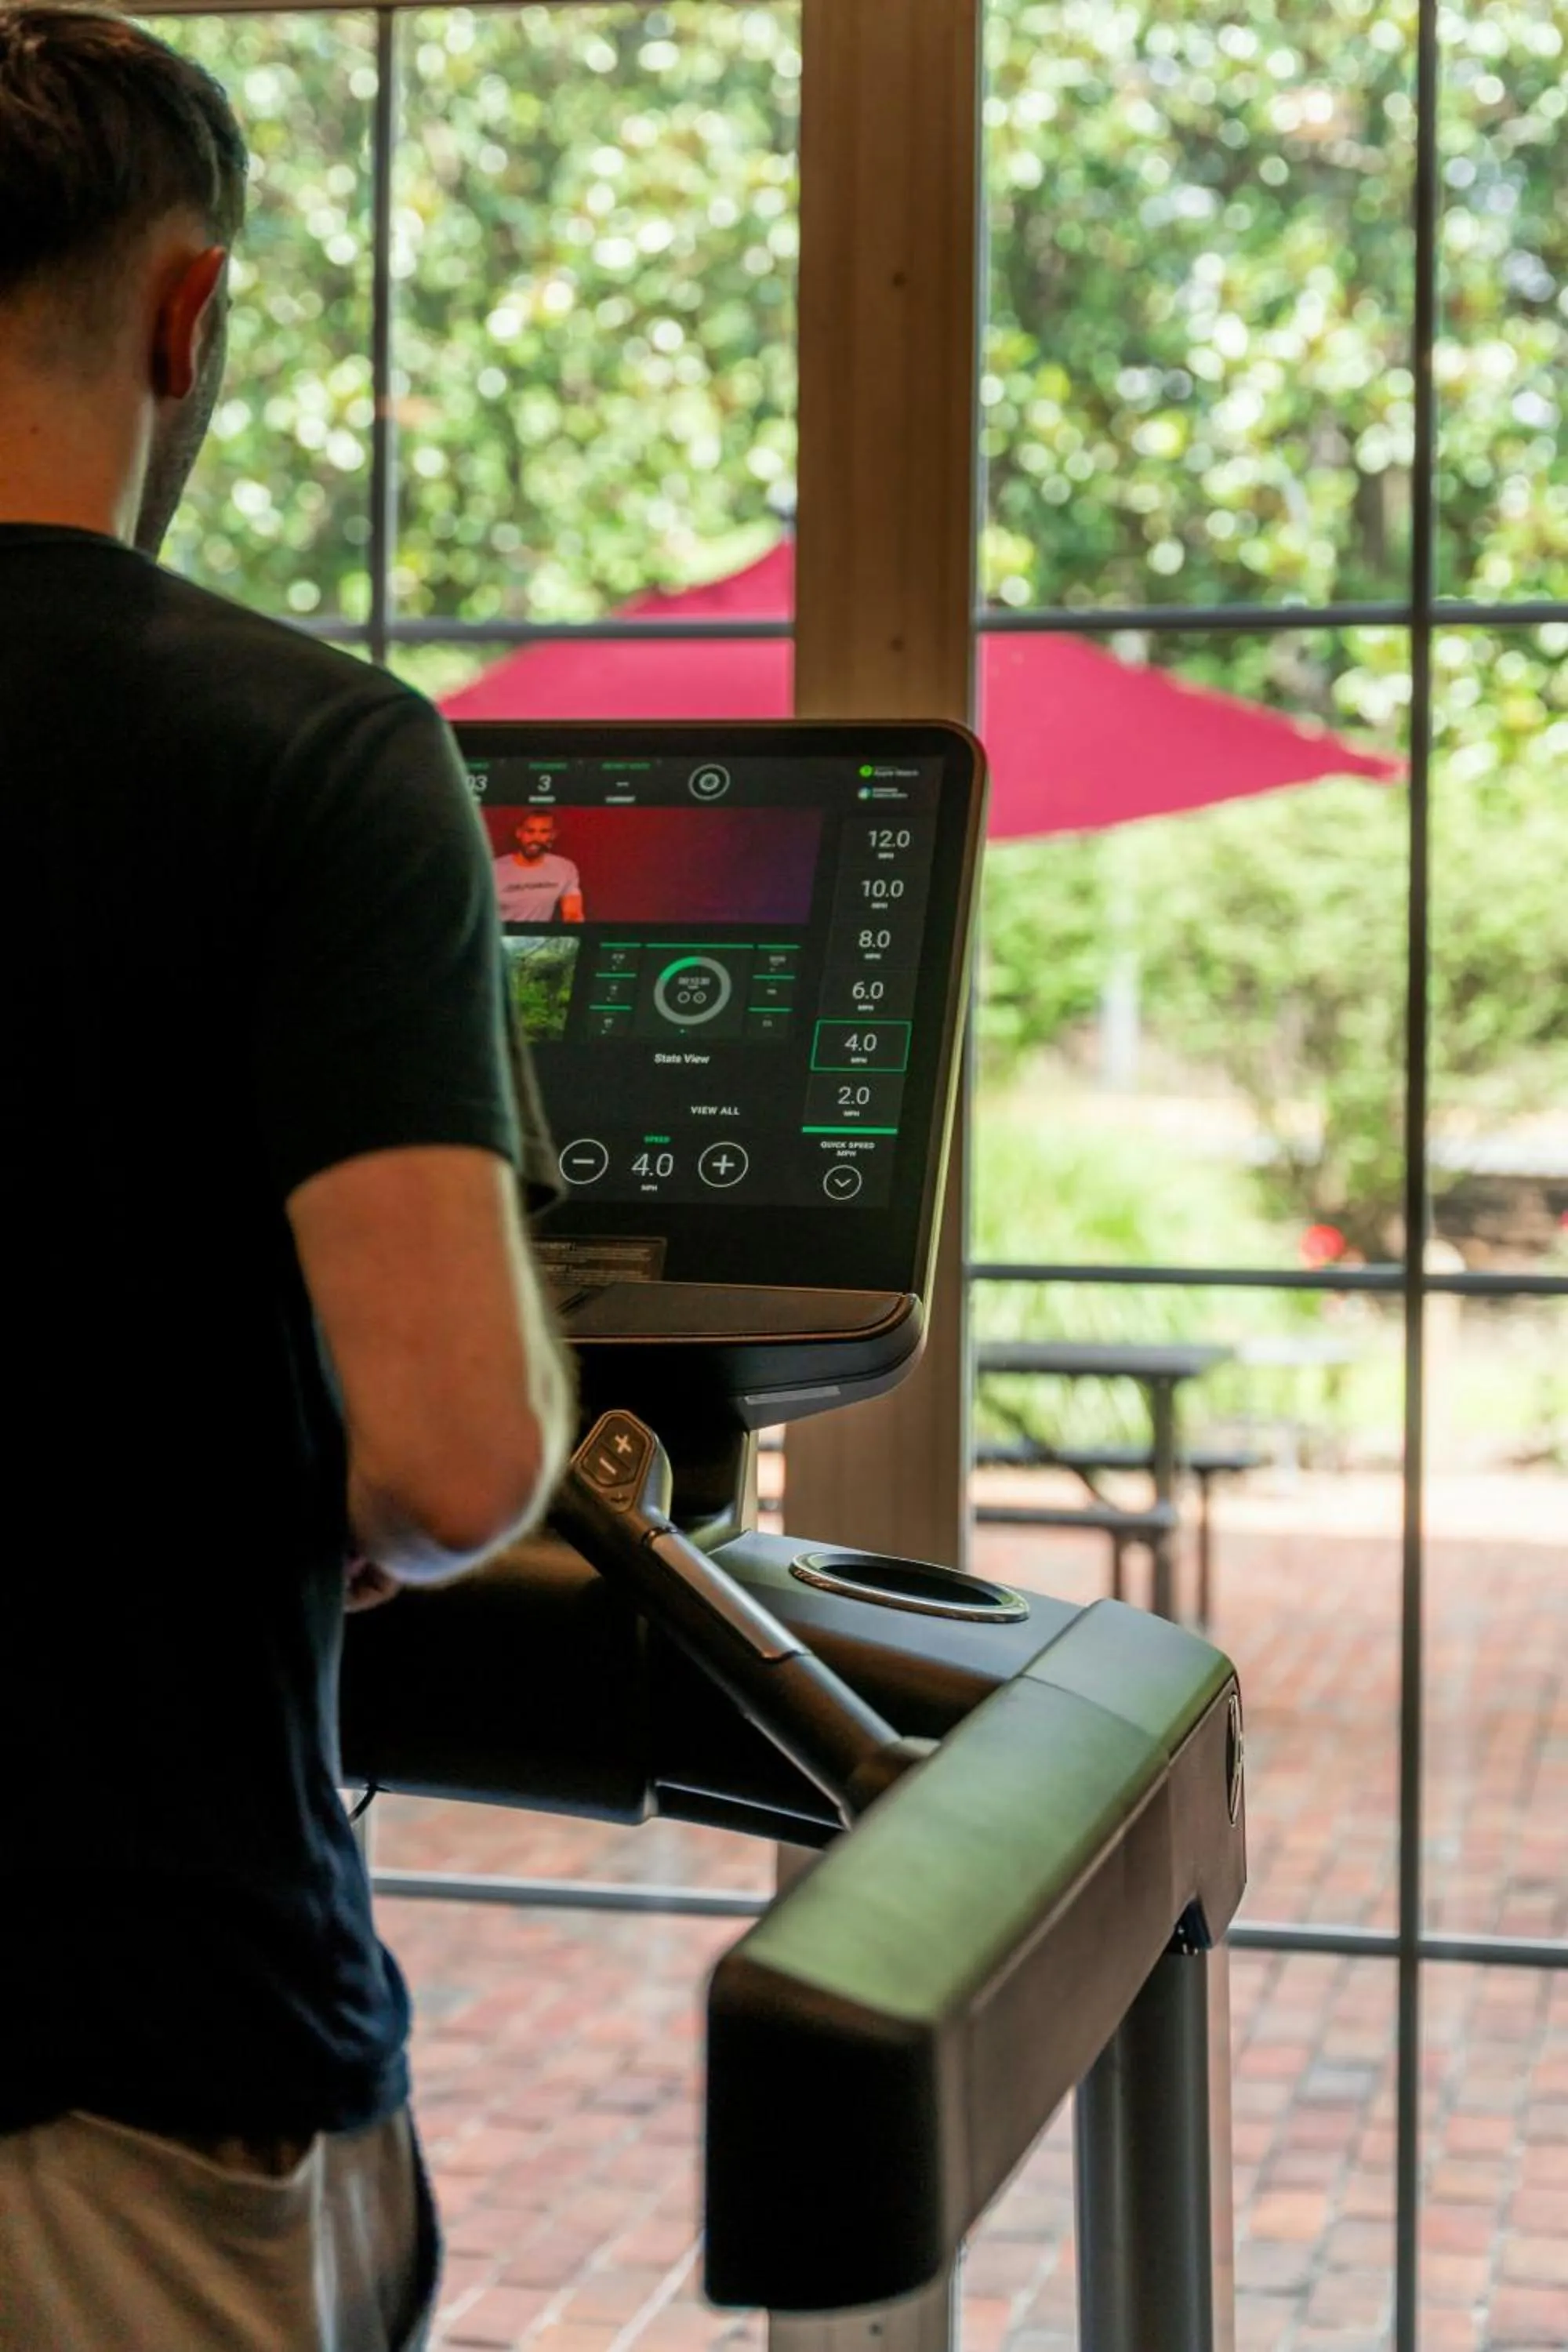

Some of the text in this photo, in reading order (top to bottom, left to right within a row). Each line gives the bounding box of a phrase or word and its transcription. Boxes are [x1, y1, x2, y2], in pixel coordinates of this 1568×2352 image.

[537, 775, 552, 792] 3
[868, 829, 910, 848] 12.0
[862, 879, 904, 898] 10.0
[858, 930, 891, 948] 8.0
[852, 982, 884, 1000] 6.0
[844, 1033, 877, 1051] 4.0
[684, 1053, 710, 1064] View
[837, 1086, 870, 1105] 2.0
[691, 1105, 740, 1116] VIEW ALL
[644, 1135, 671, 1144] SPEED
[631, 1153, 674, 1177] 4.0
